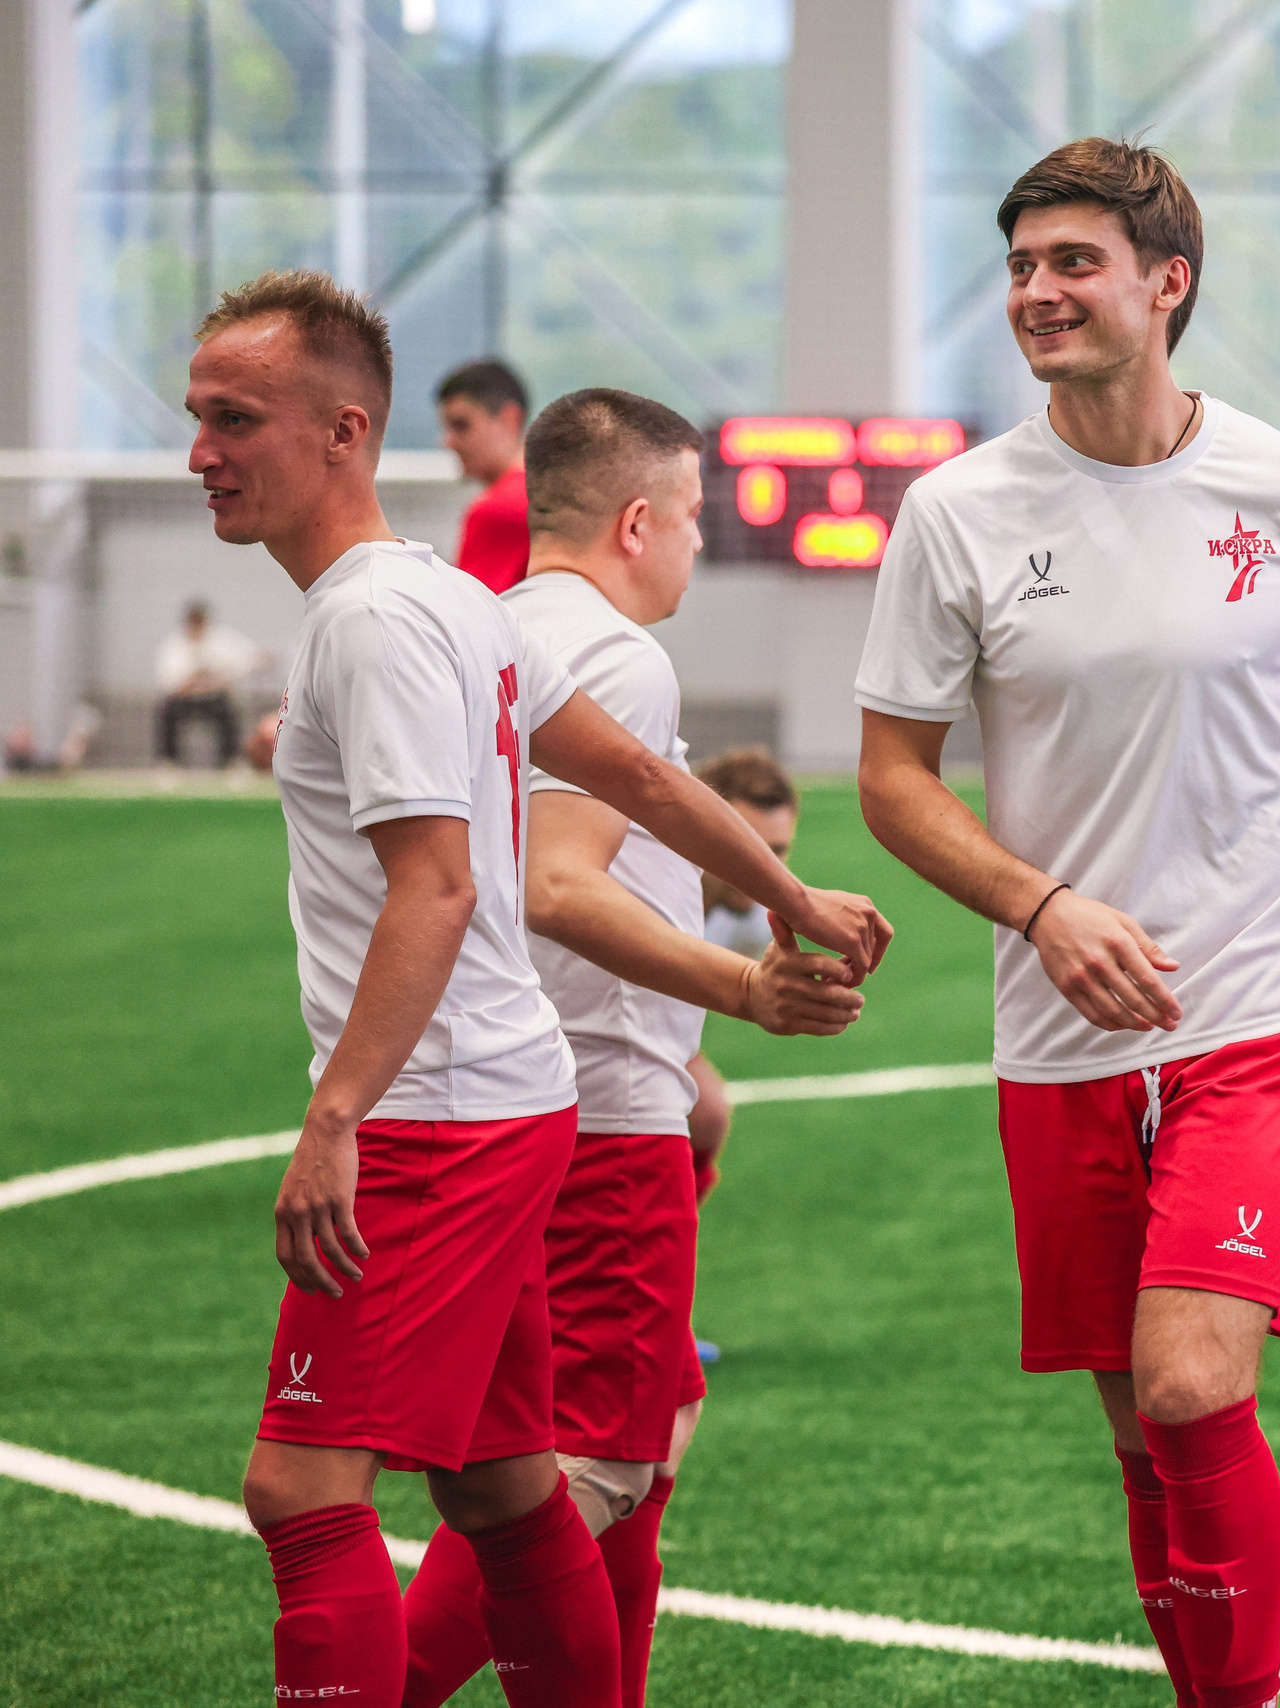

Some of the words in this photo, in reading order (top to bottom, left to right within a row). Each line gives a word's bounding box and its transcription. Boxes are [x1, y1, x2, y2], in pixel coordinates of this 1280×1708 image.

[1207, 538, 1277, 557] ИСКРА
[1017, 585, 1070, 602] JÖGEL
[1215, 1238, 1267, 1259] JÖGEL
[277, 1387, 323, 1403] JÖGEL
